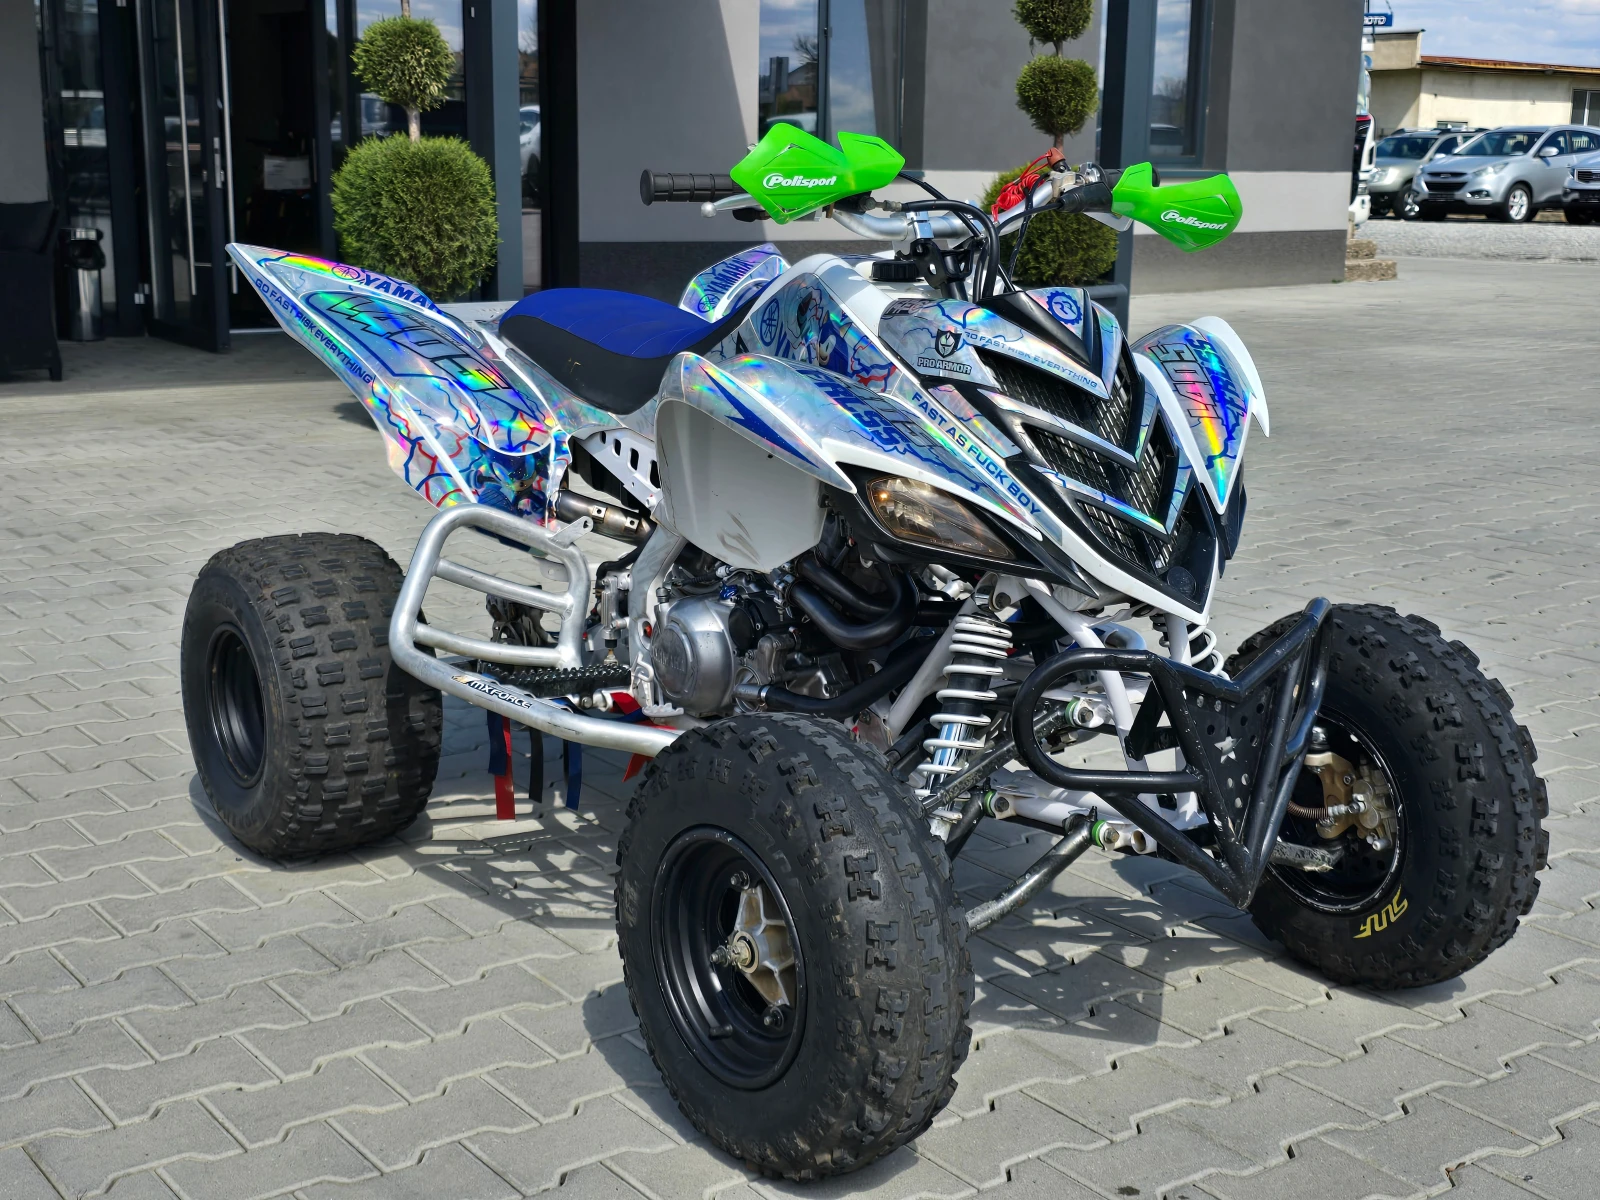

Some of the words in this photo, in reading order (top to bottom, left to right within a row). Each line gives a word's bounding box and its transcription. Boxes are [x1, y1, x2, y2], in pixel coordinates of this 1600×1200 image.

[763, 173, 837, 189] Polisport
[1161, 210, 1228, 230] Polisport
[704, 258, 754, 294] YAMAHA
[255, 278, 270, 294] GO
[269, 289, 296, 314] FAST
[295, 311, 316, 334] RISK
[314, 330, 374, 384] EVERYTHING
[917, 357, 935, 368] PRO
[935, 359, 972, 375] ARMOR
[980, 336, 1006, 349] FAST
[1034, 355, 1098, 388] EVERYTHING
[911, 391, 948, 425] FAST
[947, 427, 968, 448] AS
[967, 445, 1008, 486] FUCK
[1006, 482, 1042, 516] BOY
[469, 680, 533, 709] MXFORCE
